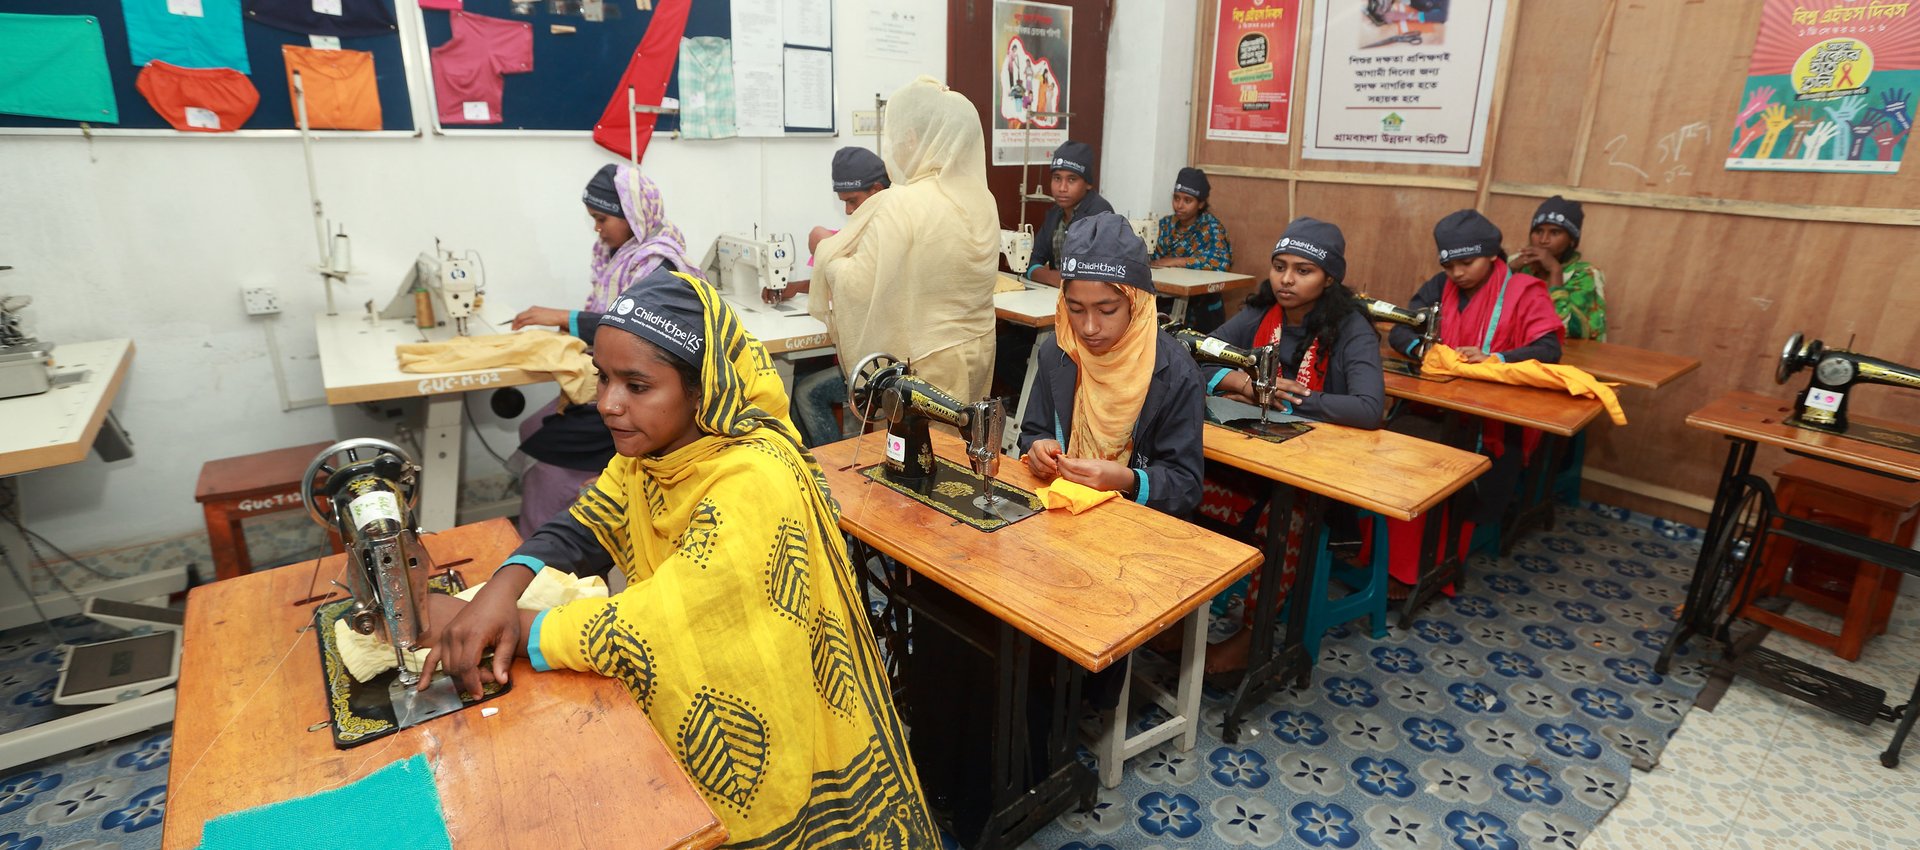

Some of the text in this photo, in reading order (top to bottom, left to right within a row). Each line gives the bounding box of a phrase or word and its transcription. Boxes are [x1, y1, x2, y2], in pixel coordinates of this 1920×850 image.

[1349, 55, 1372, 65] শিশুর
[1376, 55, 1403, 64] দক্ষতা
[1355, 66, 1440, 77] আগামী দিনের জন্য
[1354, 79, 1438, 92] সুদক্ষ নাগরিক হতে
[1402, 94, 1421, 103] হবে
[1334, 133, 1378, 143] গ্রামবাংলা
[1416, 132, 1448, 144] কমিটি
[1077, 261, 1116, 273] ChildHope
[1117, 264, 1127, 277] 25
[634, 306, 704, 351] ChildHope 25
